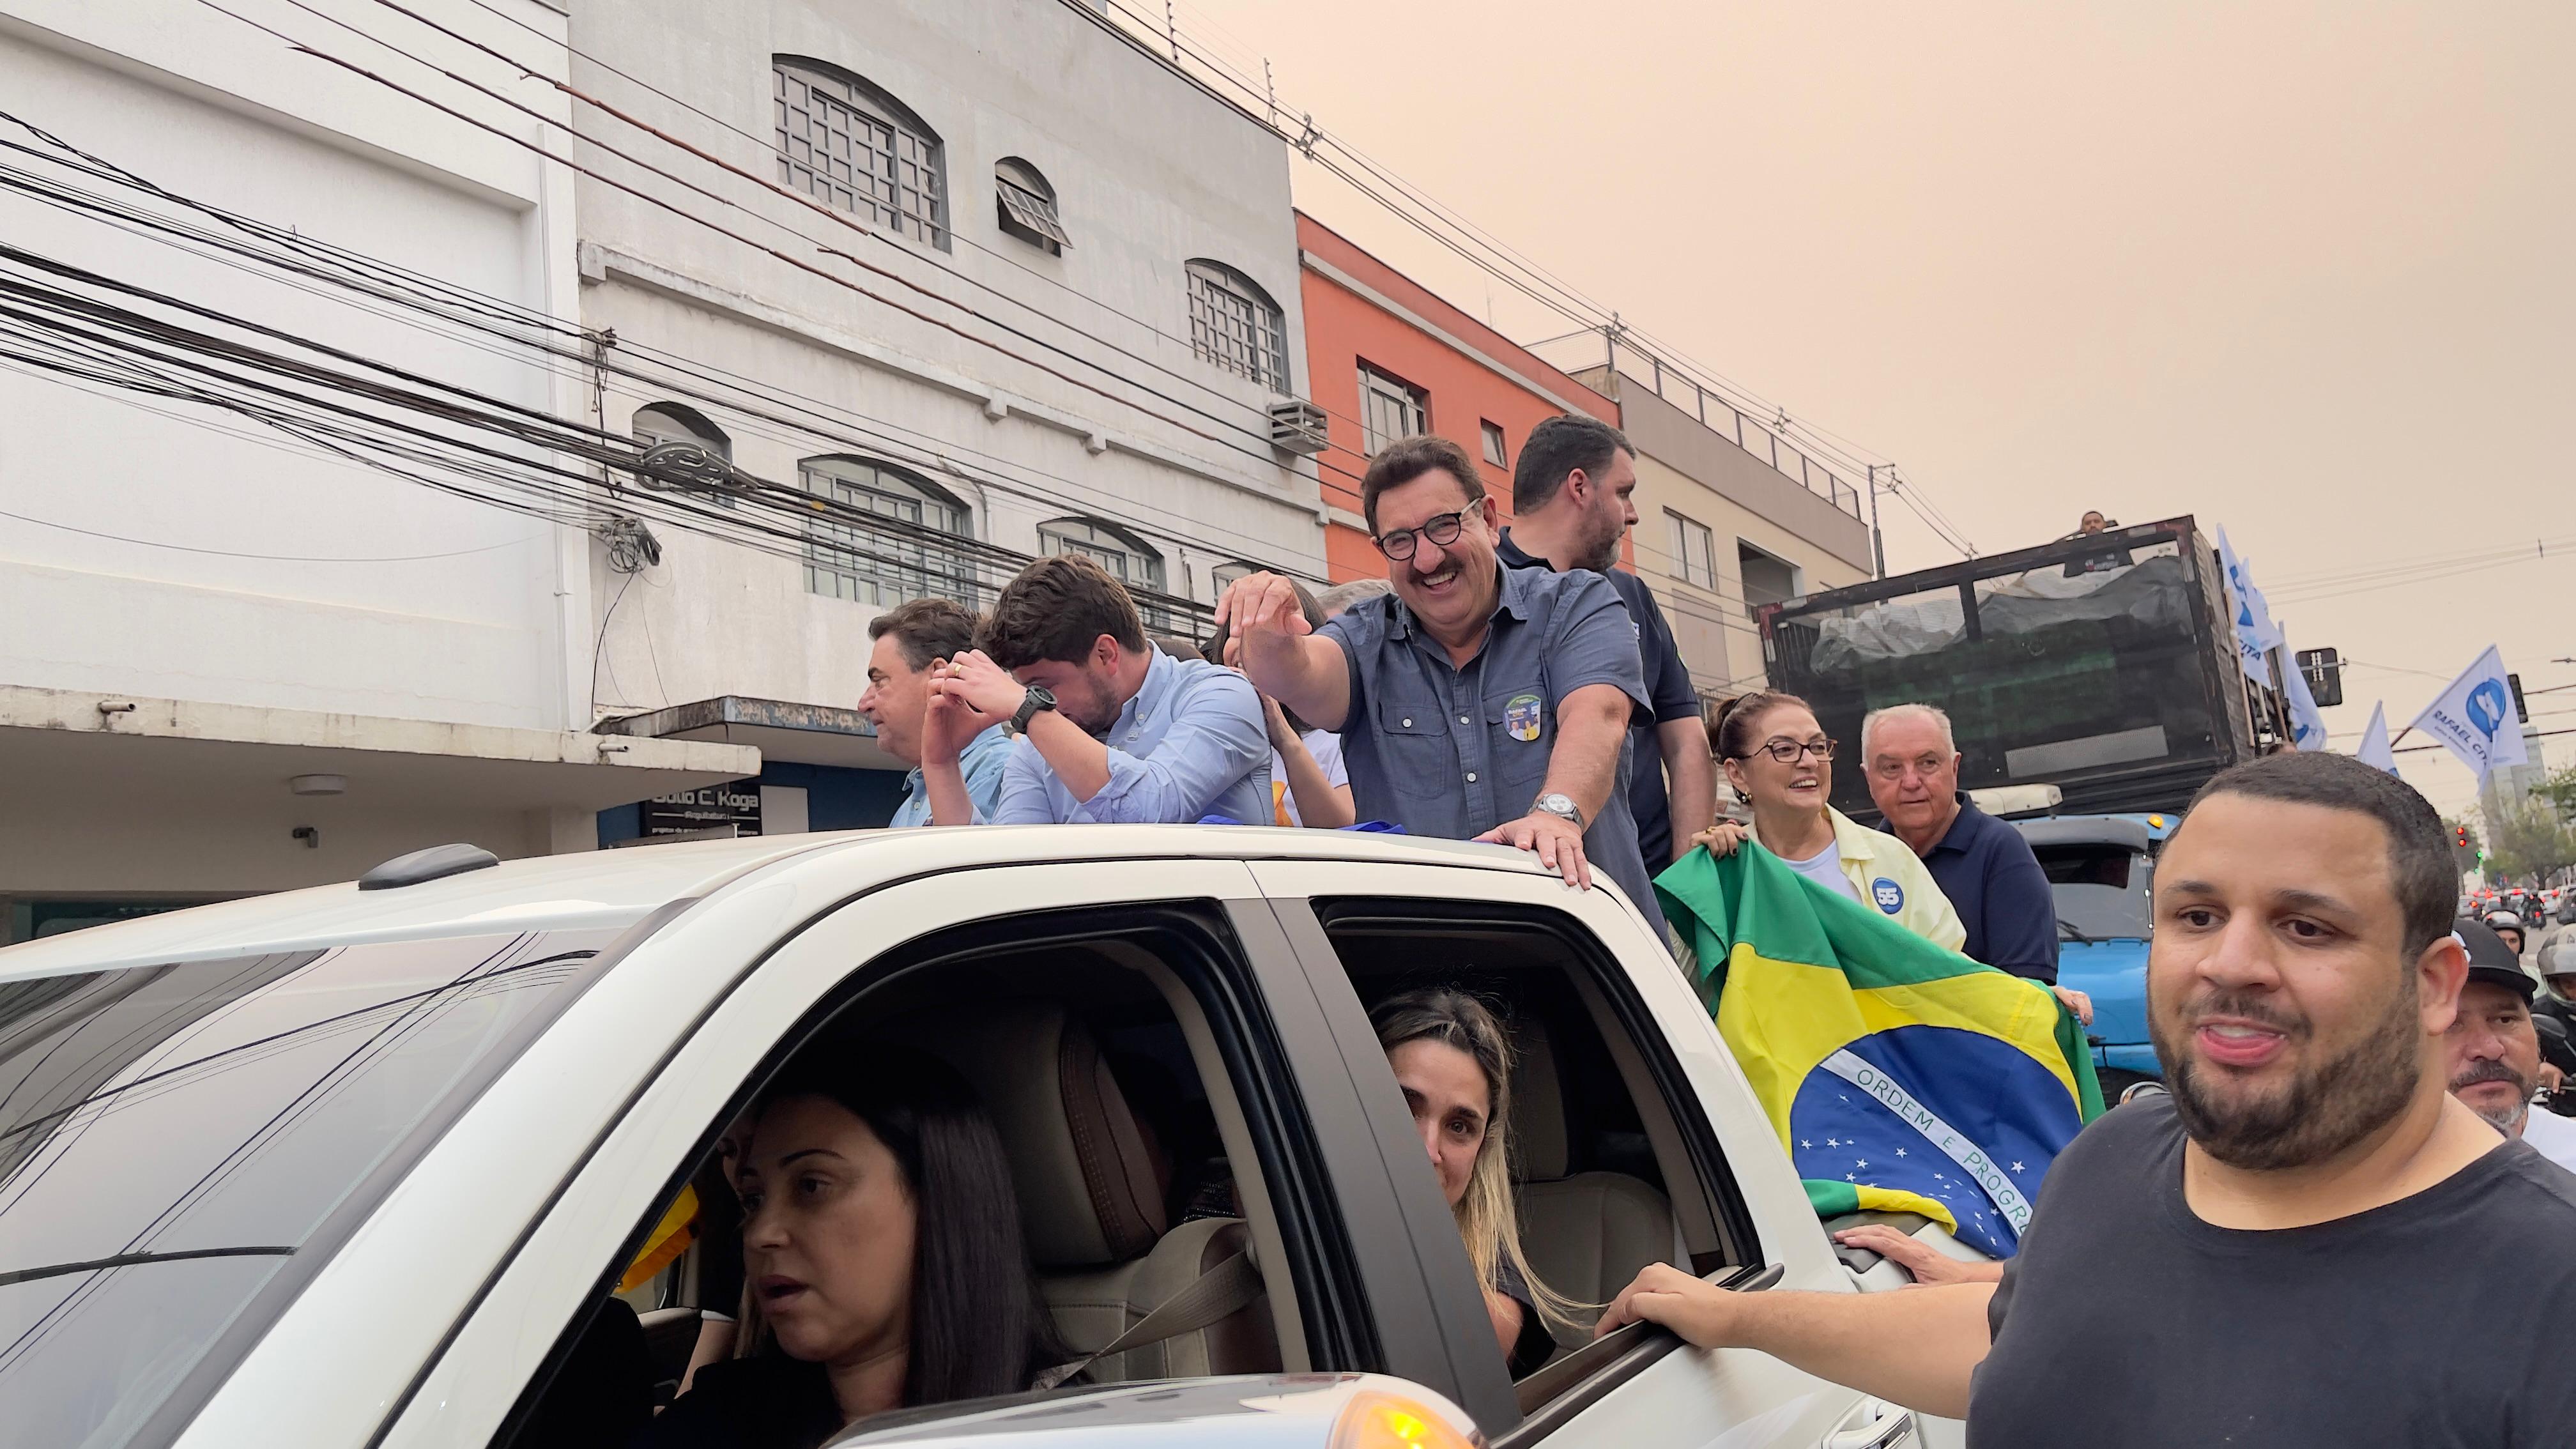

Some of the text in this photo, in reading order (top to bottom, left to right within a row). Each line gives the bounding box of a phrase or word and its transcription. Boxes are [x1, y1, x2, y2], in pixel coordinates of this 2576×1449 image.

[2432, 710, 2471, 744] RAFAEL
[717, 791, 758, 811] Koga
[1876, 887, 1899, 905] 55
[1857, 1069, 1934, 1131] ORDEM
[1942, 1136, 1956, 1149] E
